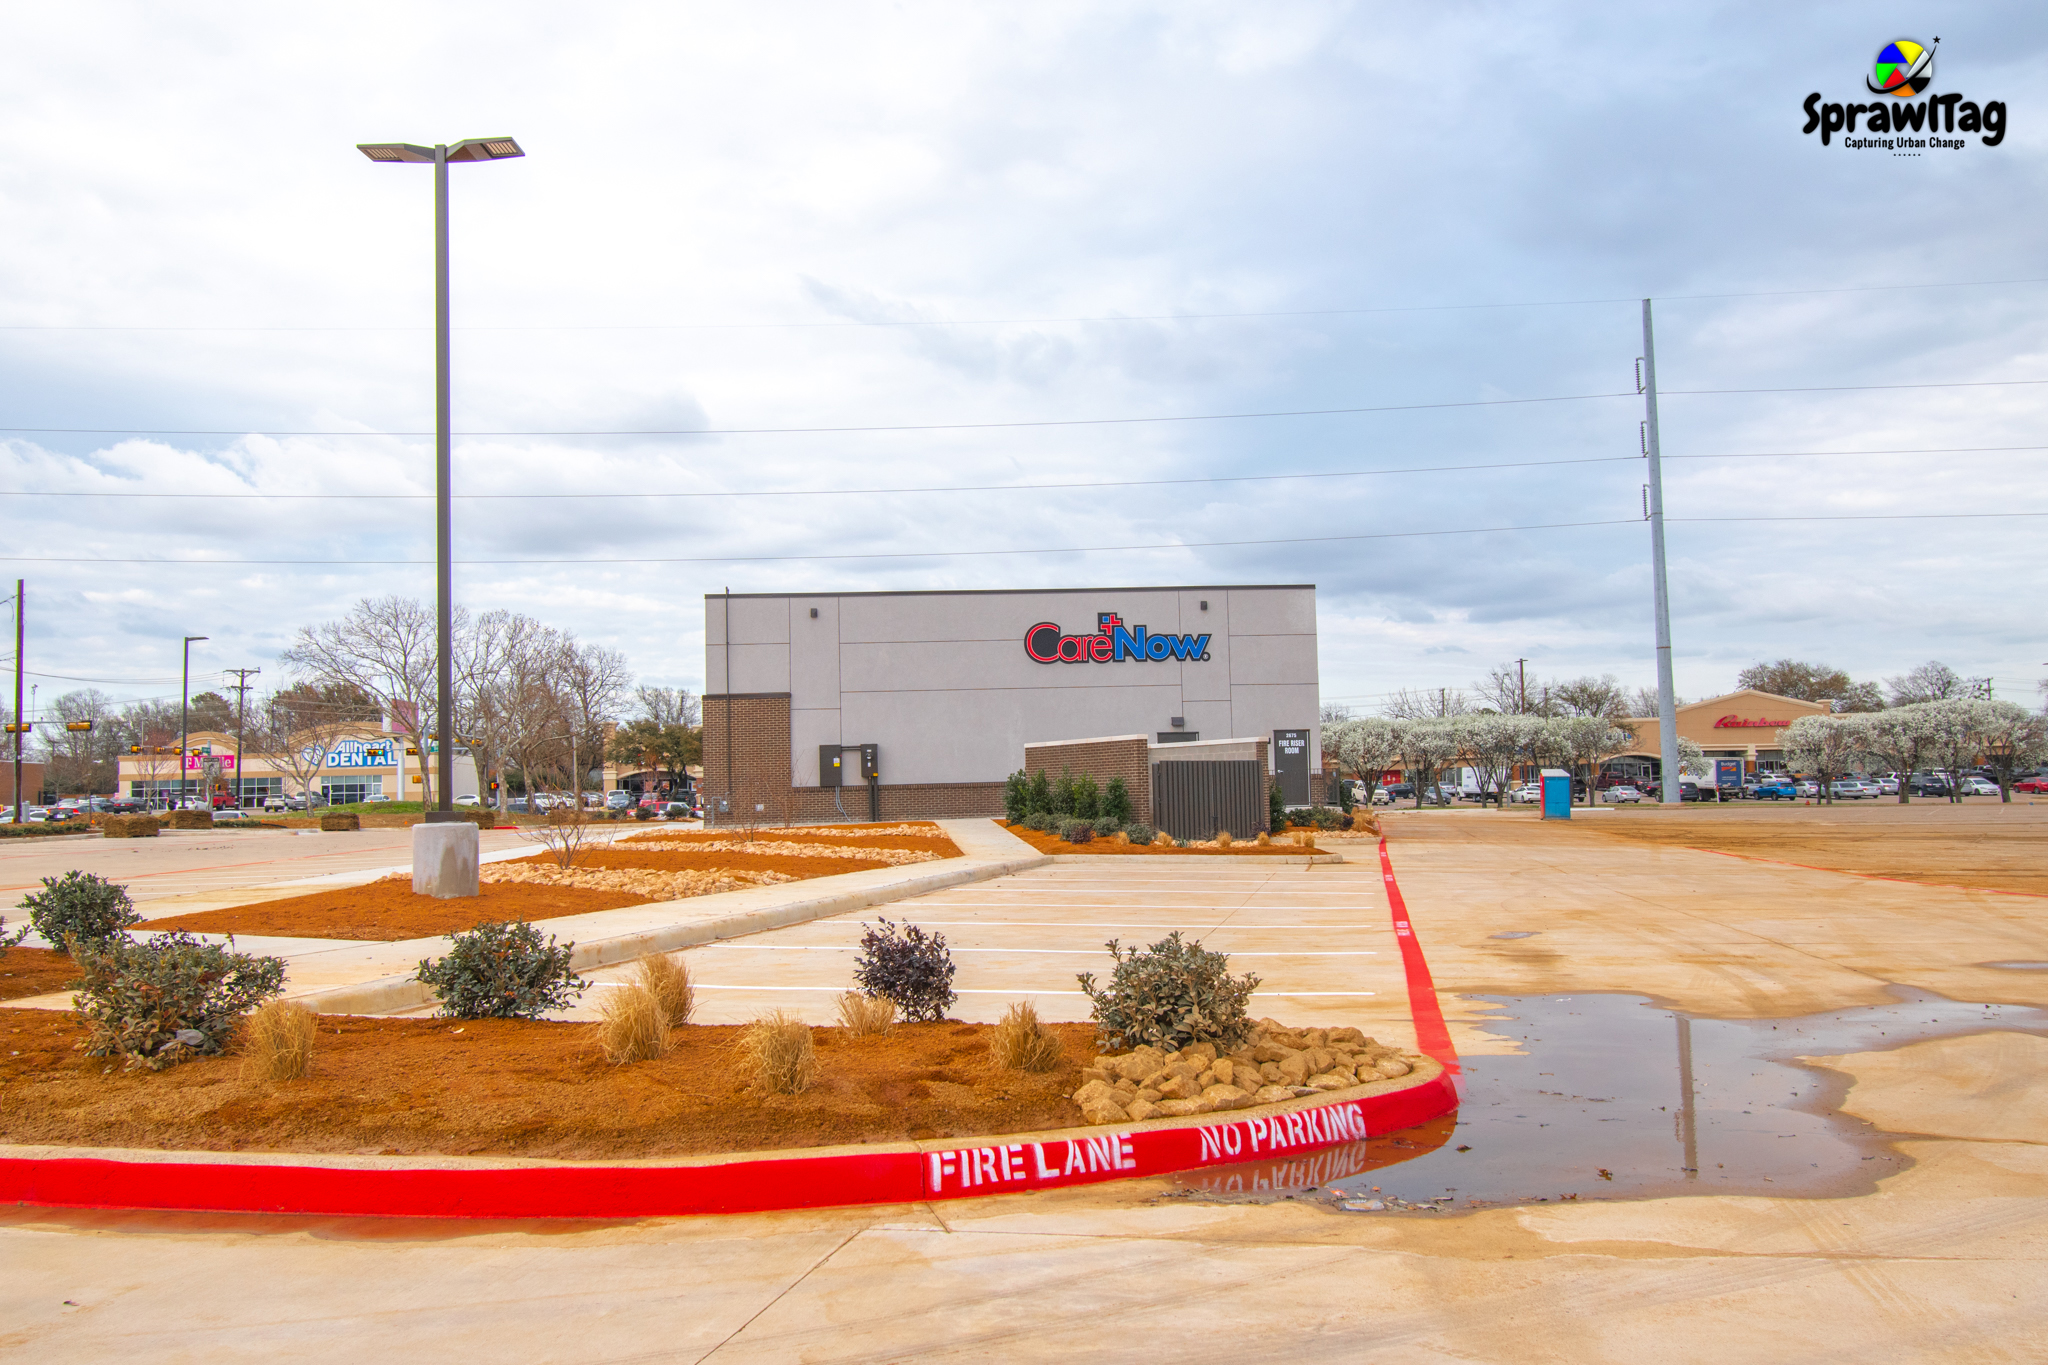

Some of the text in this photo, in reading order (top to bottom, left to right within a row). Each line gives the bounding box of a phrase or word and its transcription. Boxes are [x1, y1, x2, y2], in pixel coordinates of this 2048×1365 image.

[1025, 623, 1212, 663] CareNow
[1713, 714, 1791, 728] Rainbow
[327, 753, 398, 767] DENTAL
[335, 740, 392, 753] Allheart
[1199, 1103, 1367, 1162] NO PARKING
[930, 1132, 1137, 1192] FIRE LANE
